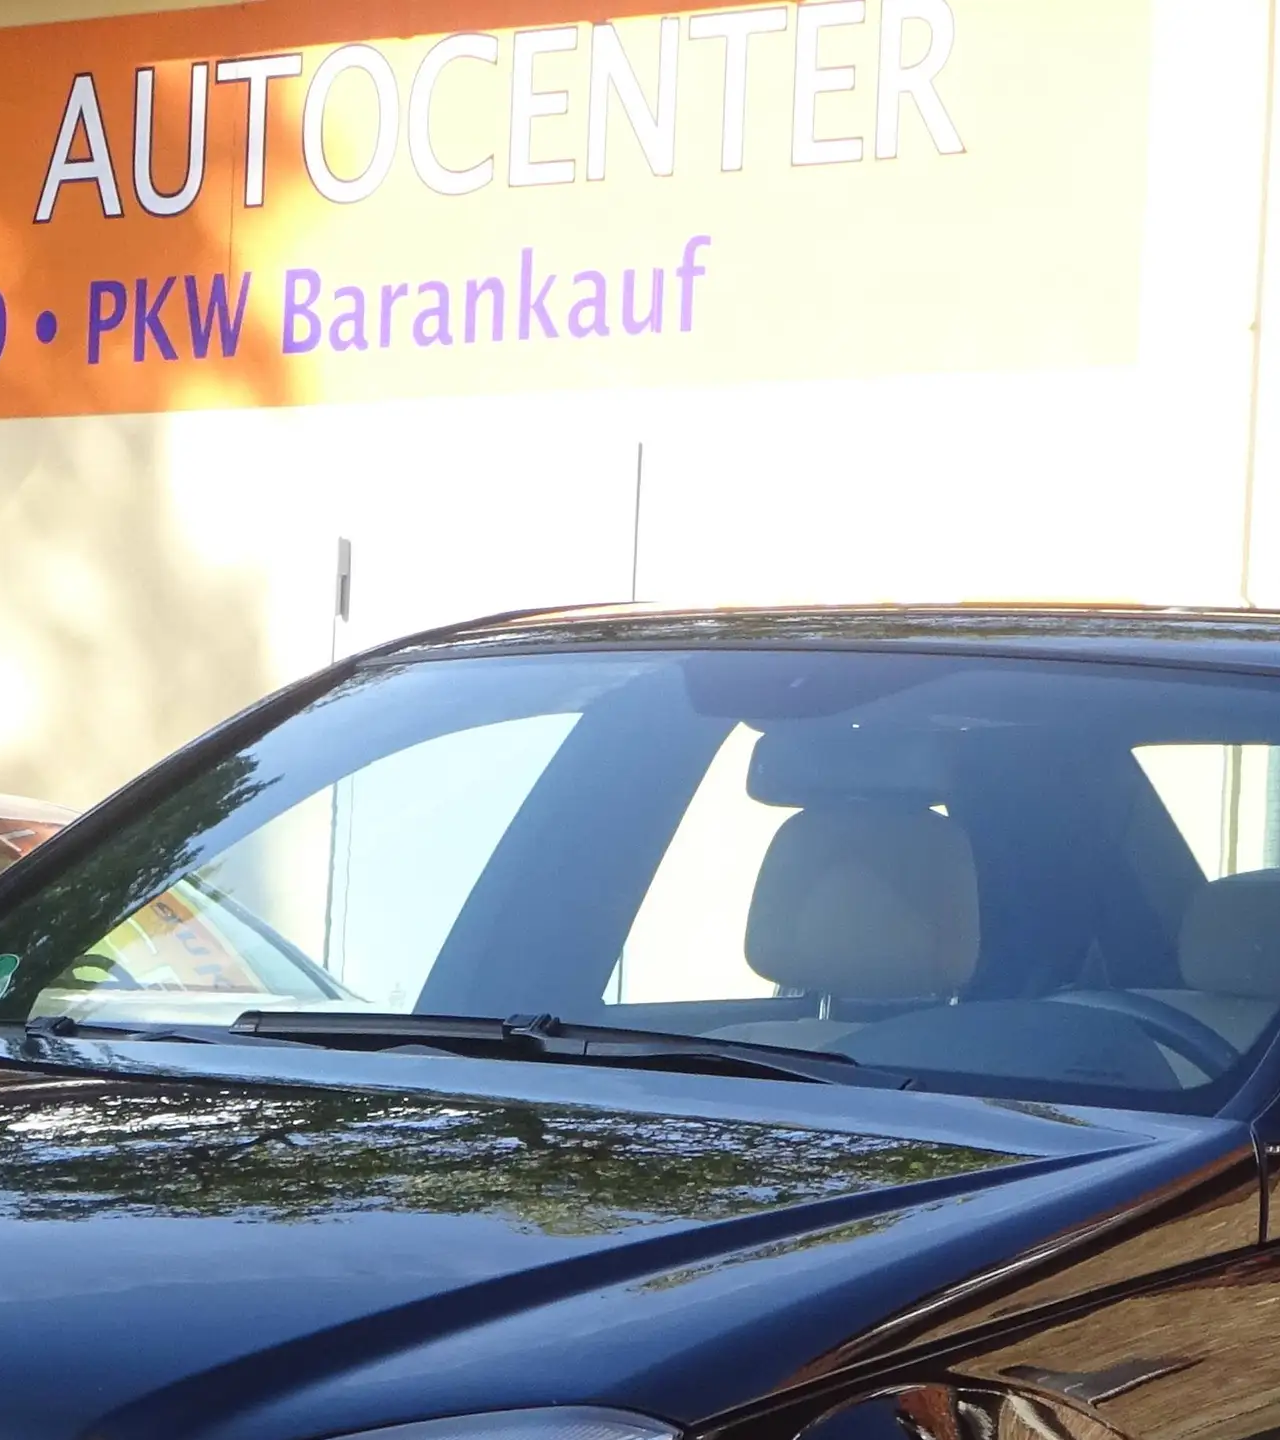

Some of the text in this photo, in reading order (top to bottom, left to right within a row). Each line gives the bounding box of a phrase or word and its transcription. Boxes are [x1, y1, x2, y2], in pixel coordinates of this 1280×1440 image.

[32, 0, 967, 224] AUTOCENTER
[86, 271, 252, 366] PKW
[280, 235, 712, 357] Barankauf
